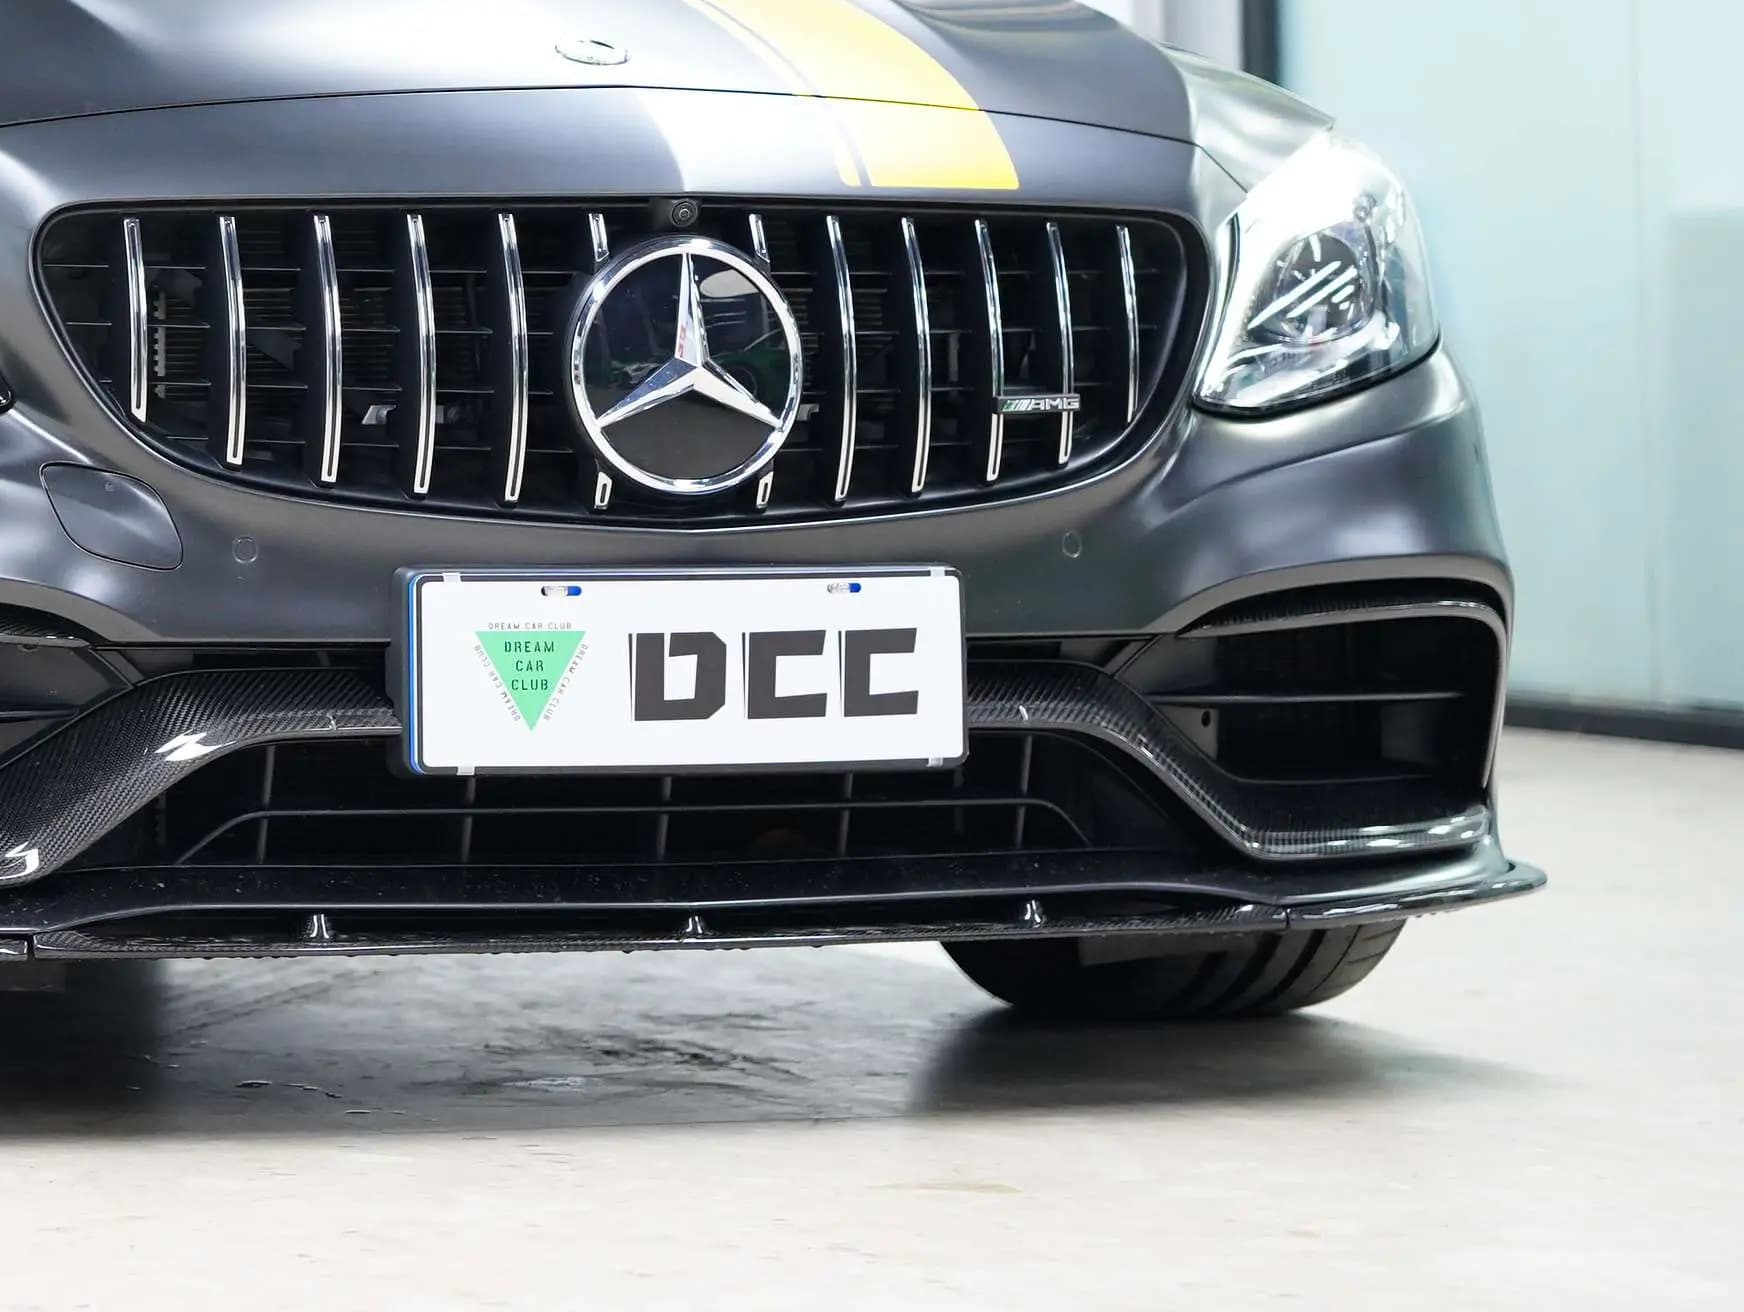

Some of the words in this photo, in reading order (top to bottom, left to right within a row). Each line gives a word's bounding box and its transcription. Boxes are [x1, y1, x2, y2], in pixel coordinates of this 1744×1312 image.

[1028, 398, 1079, 410] AMG
[488, 622, 520, 630] DREAM
[525, 622, 543, 630] CAR
[548, 622, 572, 630] CLUB
[504, 641, 554, 653] DREAM
[515, 660, 544, 672] CAR
[628, 627, 919, 722] DCC
[511, 679, 549, 690] CLUB
